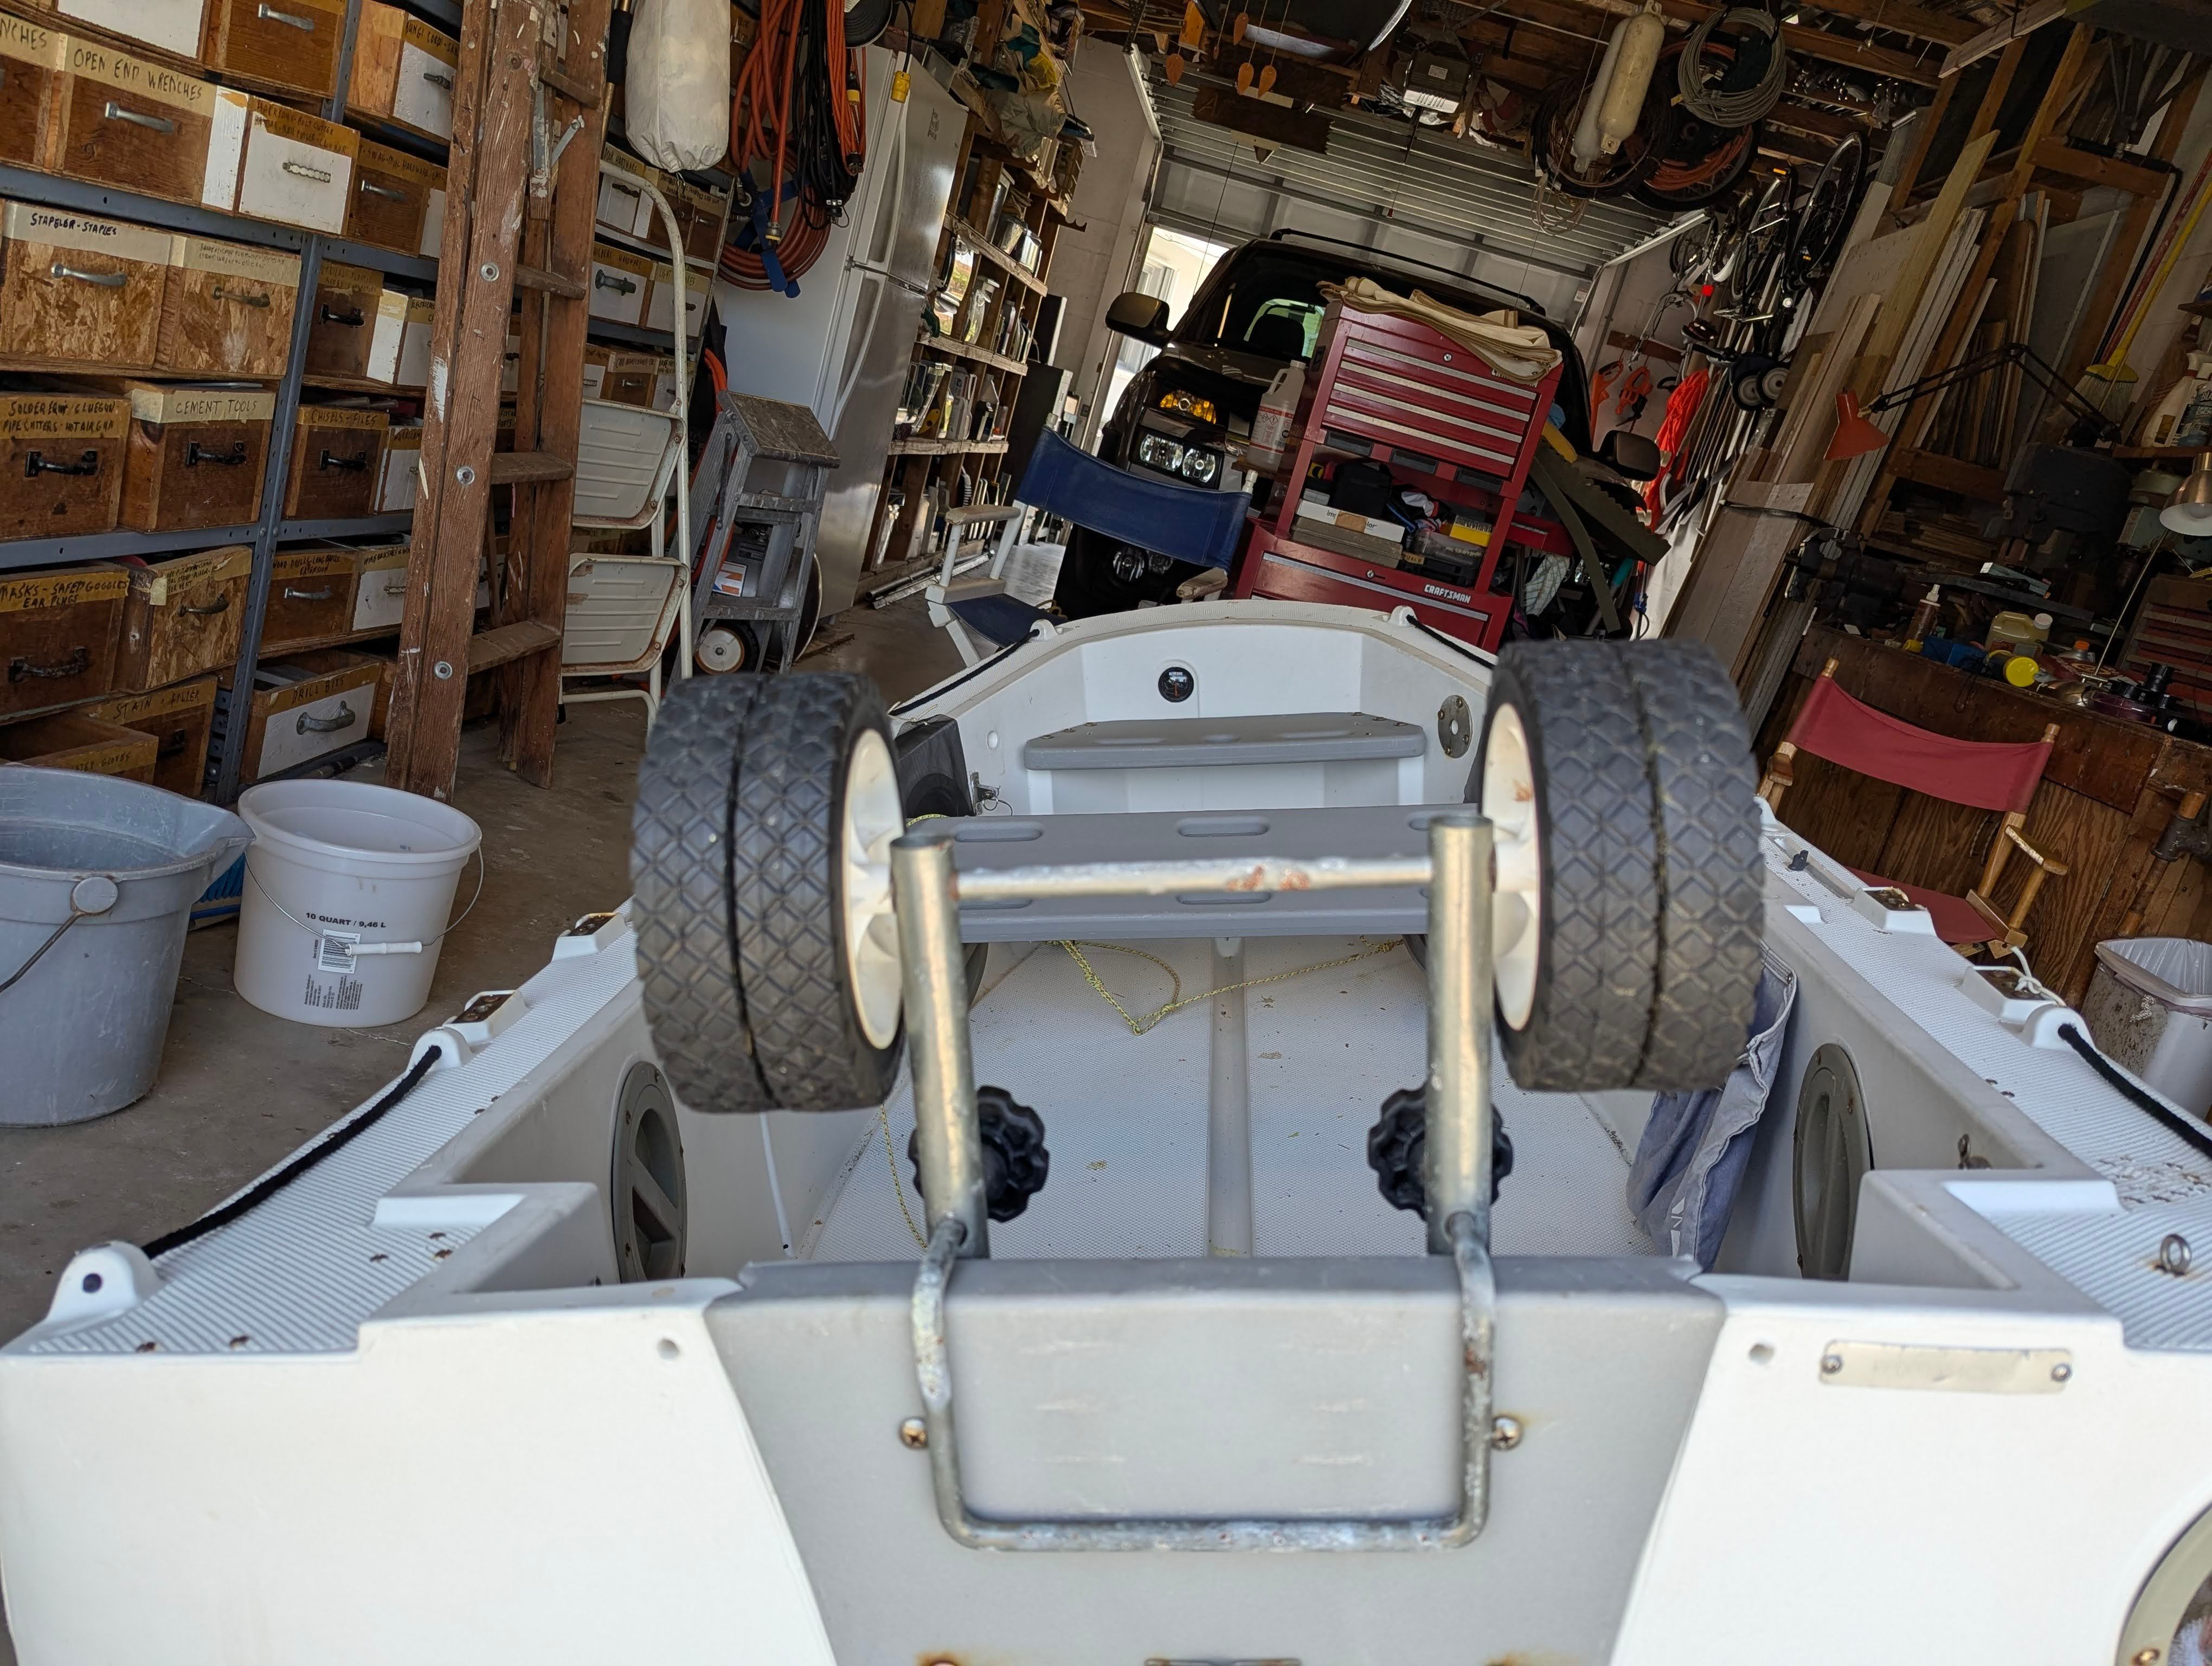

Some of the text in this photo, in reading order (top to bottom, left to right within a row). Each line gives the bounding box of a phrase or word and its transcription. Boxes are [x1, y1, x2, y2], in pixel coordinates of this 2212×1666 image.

[74, 48, 203, 100] OPEN END WRENCHES
[313, 123, 334, 136] CUTTER
[402, 159, 429, 177] HARDWARE
[81, 221, 118, 236] STAPLES
[8, 400, 46, 417] SOLDER
[176, 399, 258, 414] CEMENT TOOLS
[3, 419, 22, 432] PIPE
[24, 420, 58, 432] CUTTERS
[311, 408, 343, 424] CHISELS
[352, 413, 378, 427] FILES
[0, 582, 40, 602] MASKS
[85, 580, 127, 592] GOGGLES
[1424, 584, 1471, 604] CRAFTSMAN
[23, 594, 79, 608] EAR PLUGS
[291, 675, 344, 706] DRILL BITS
[112, 695, 152, 720] STAIN
[170, 689, 200, 707] FILLER
[319, 915, 352, 926] QUART
[358, 920, 378, 928] 9,46
